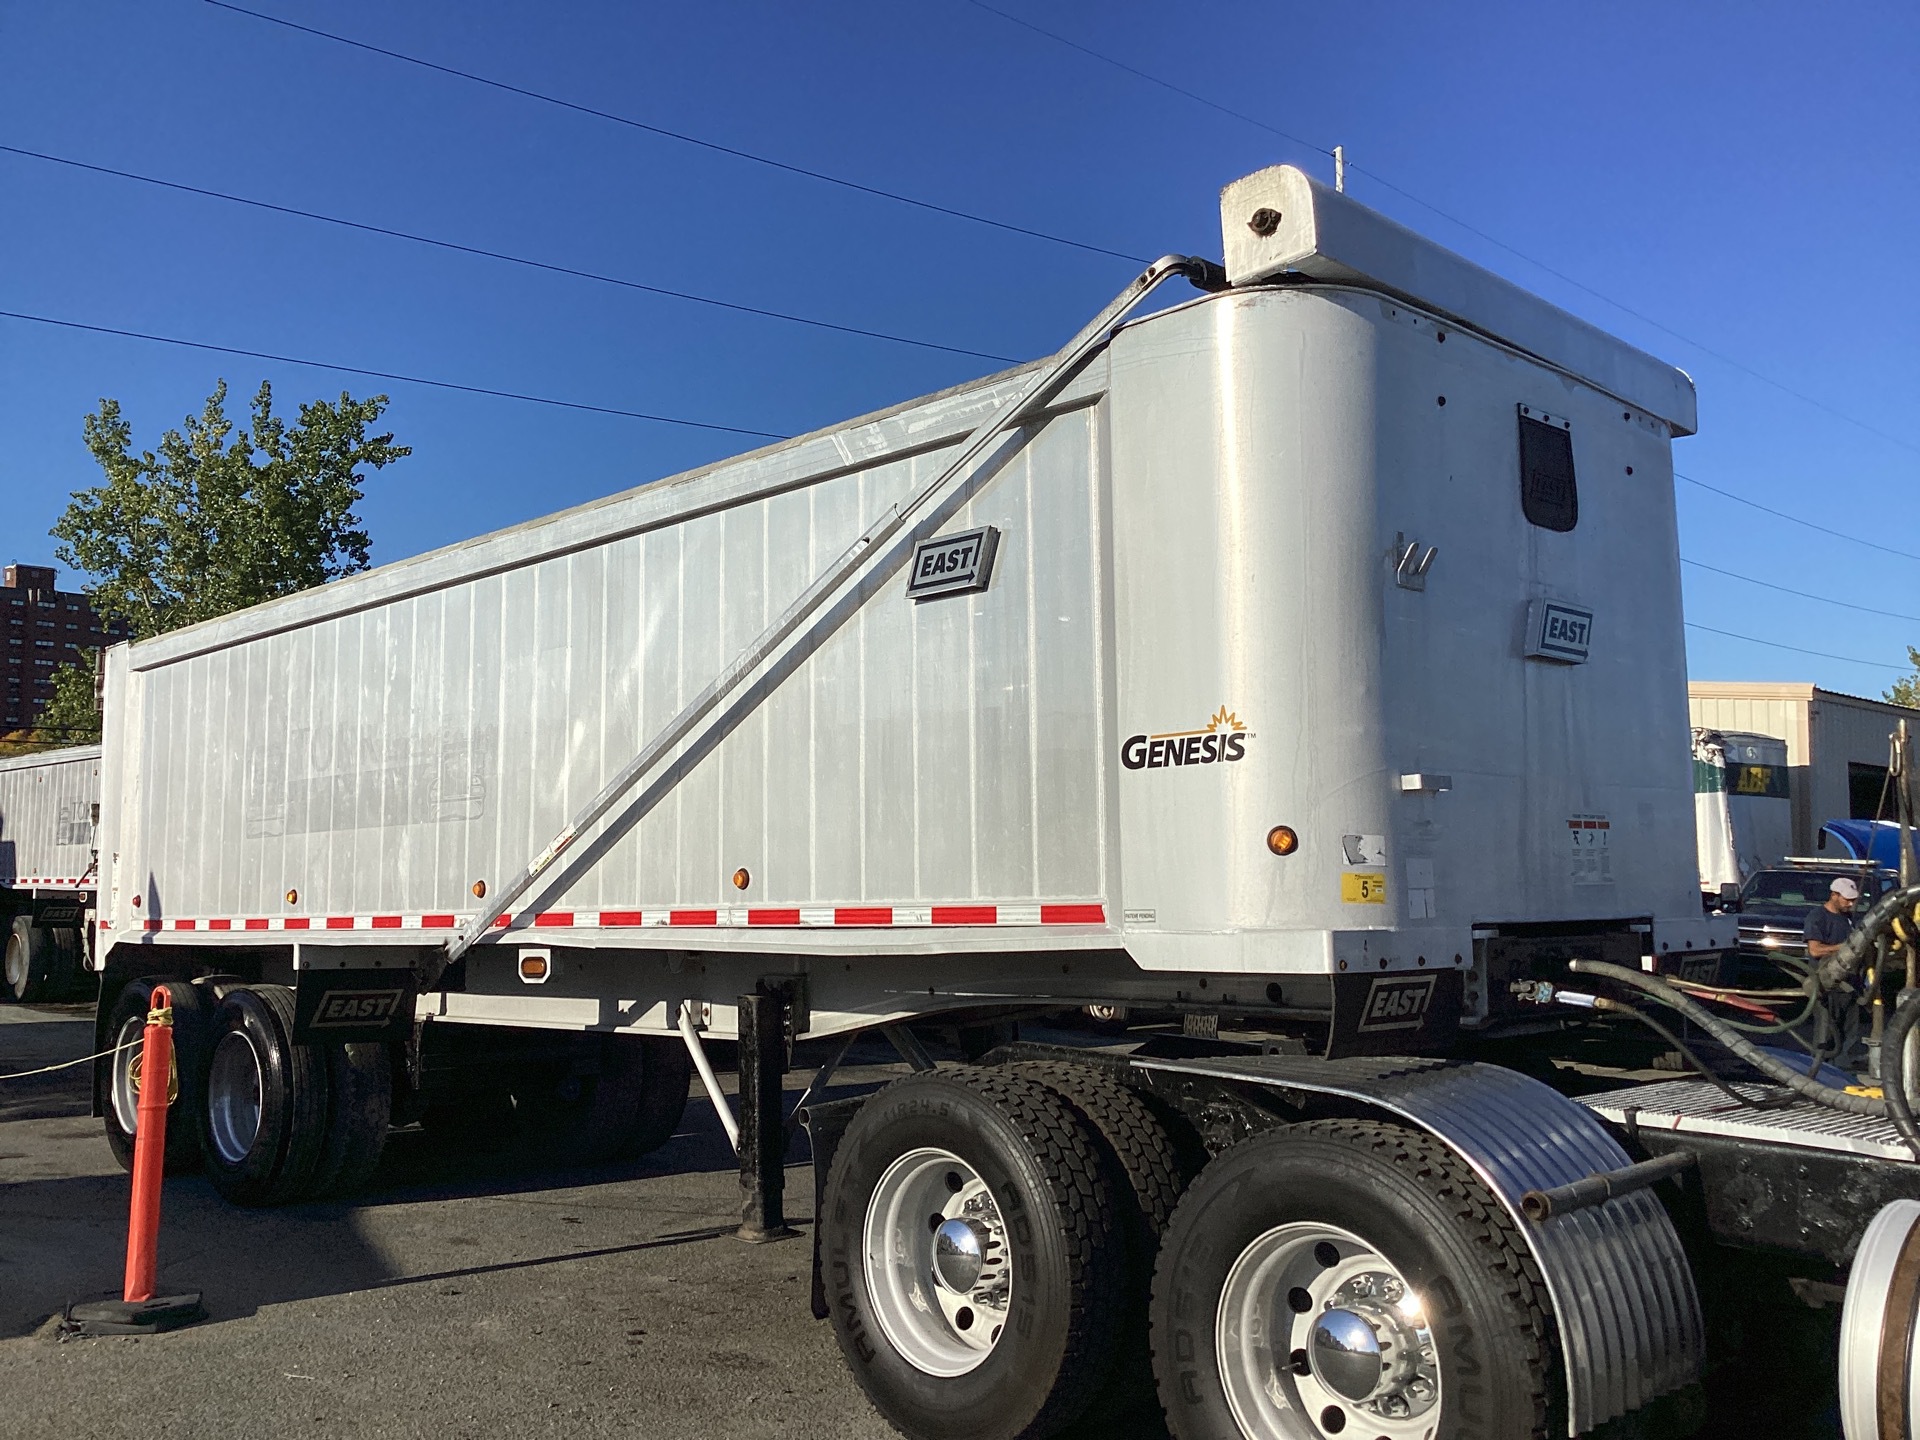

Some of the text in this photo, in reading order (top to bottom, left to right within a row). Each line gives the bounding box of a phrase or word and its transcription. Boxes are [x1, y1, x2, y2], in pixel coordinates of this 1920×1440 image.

[920, 547, 973, 577] EAST
[1549, 617, 1587, 644] EAST
[1121, 733, 1246, 770] GENESIS
[1361, 880, 1369, 899] 5
[325, 997, 392, 1018] EAST
[1370, 988, 1427, 1017] EAST
